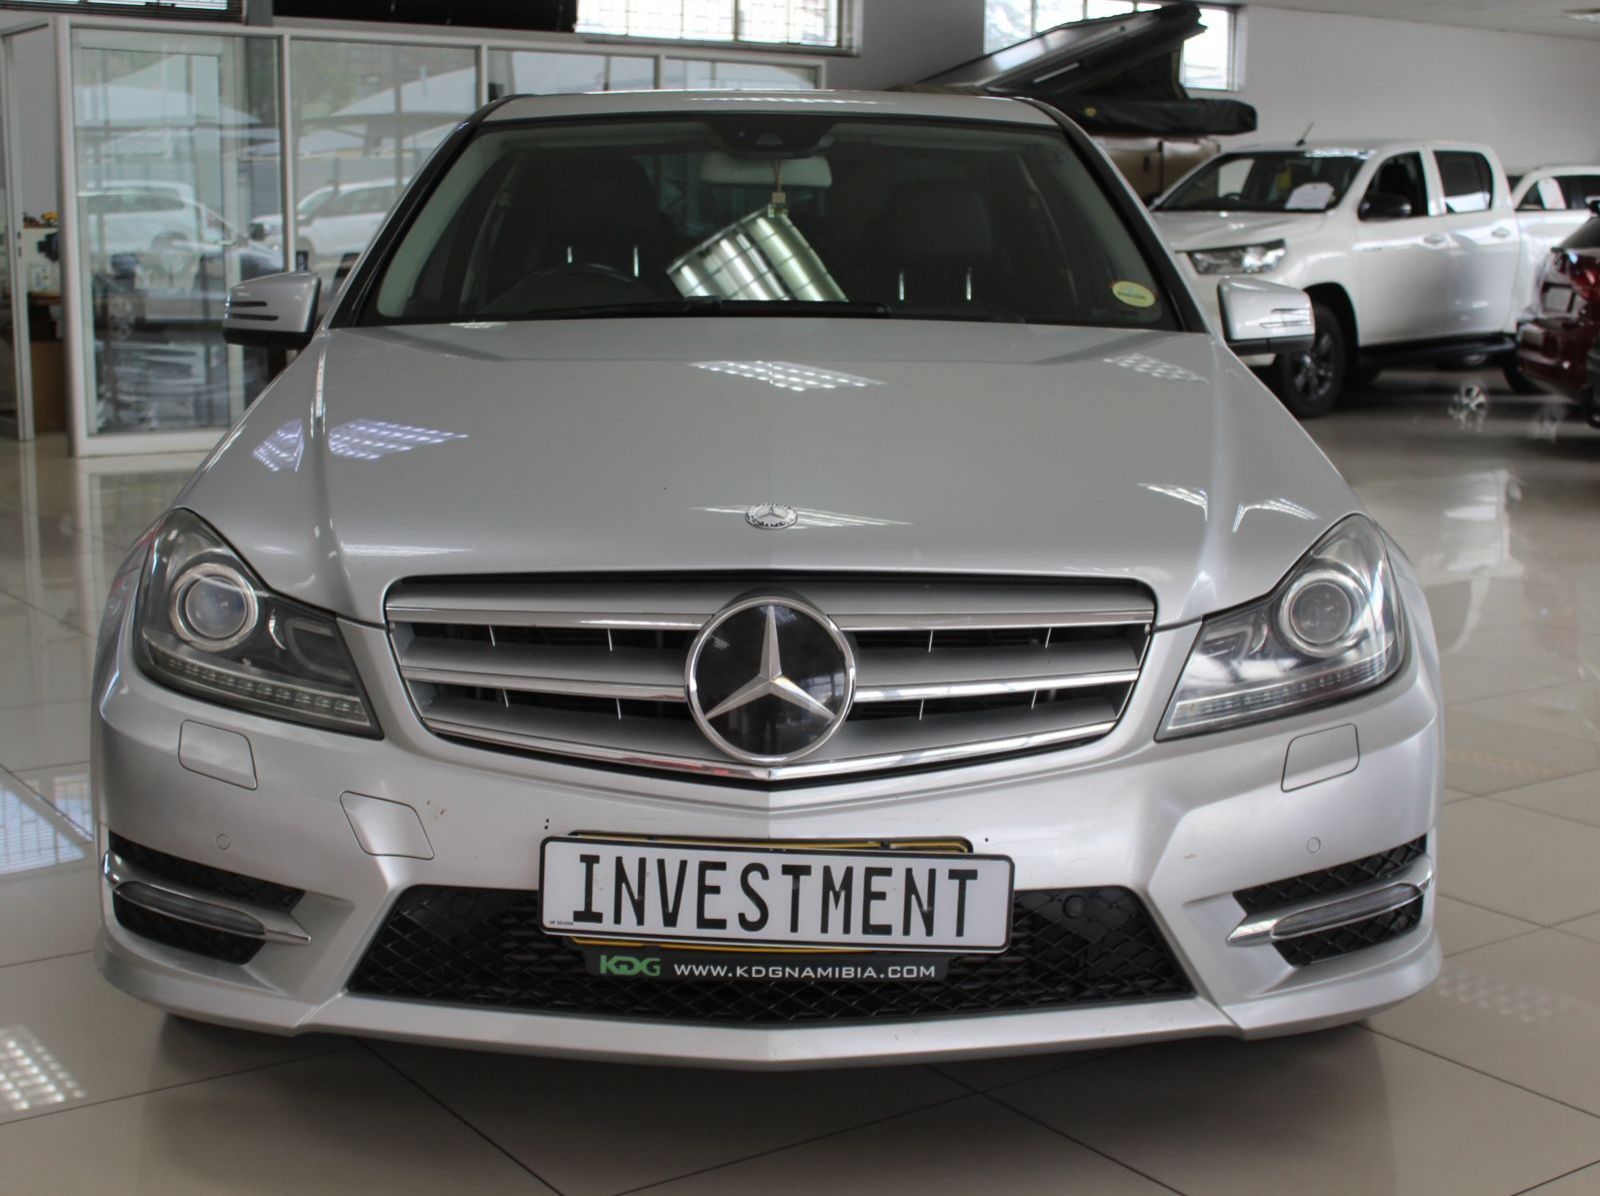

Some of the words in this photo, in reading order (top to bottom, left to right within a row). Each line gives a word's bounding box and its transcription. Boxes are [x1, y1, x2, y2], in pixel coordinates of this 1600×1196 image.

[573, 854, 978, 937] INVESTMENT
[600, 955, 661, 977] KDG
[673, 963, 936, 979] WWW.KDGNAMIBIA.COM
